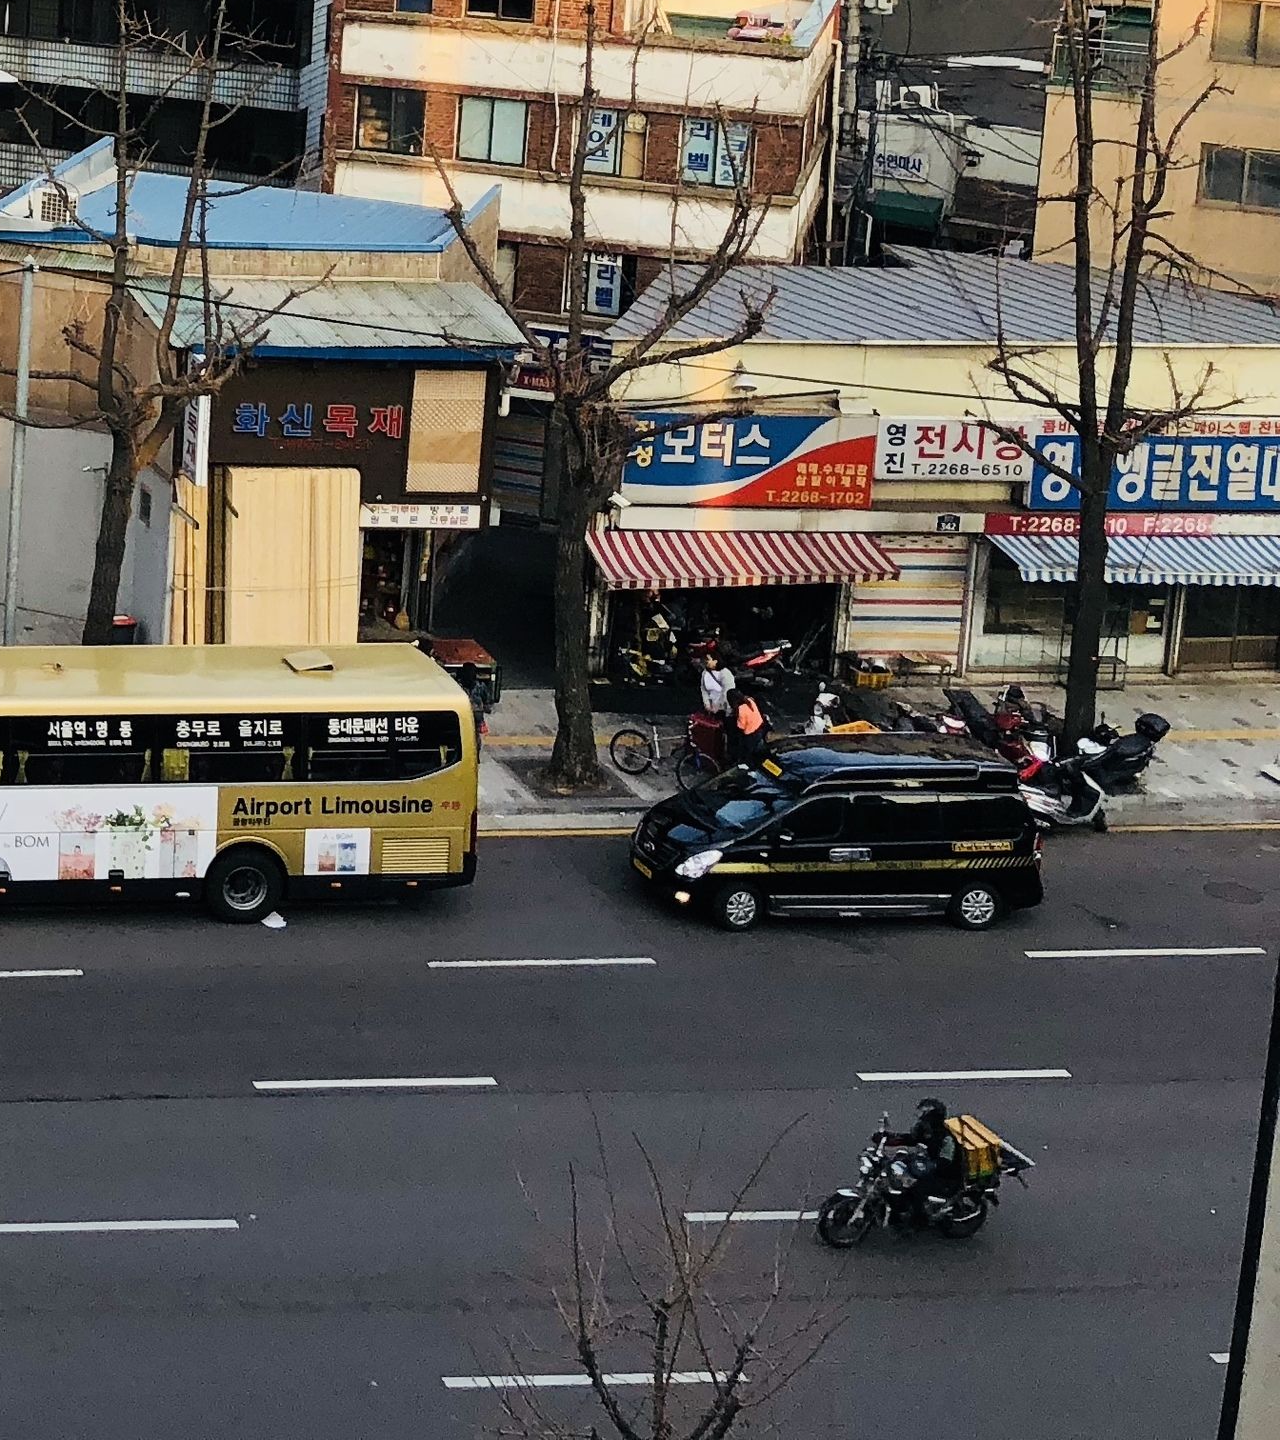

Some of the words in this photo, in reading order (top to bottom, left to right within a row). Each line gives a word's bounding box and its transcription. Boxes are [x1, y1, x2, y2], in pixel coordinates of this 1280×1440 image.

[233, 402, 405, 439] 화신목재
[661, 423, 771, 467] 모터스
[884, 423, 907, 475] 영진
[914, 424, 1028, 461] 전시장
[911, 463, 1023, 477] T.2268-6510
[766, 489, 864, 504] T.2268-1702
[940, 521, 957, 531] 342
[1010, 516, 1127, 534] T:2268-10
[176, 720, 222, 738] 충무로
[238, 719, 284, 737] 을지로
[328, 717, 389, 735] 동대문패션
[394, 716, 420, 734] 타운
[232, 796, 313, 818] Airport
[322, 795, 433, 815] Limousine
[14, 835, 50, 848] BOM
